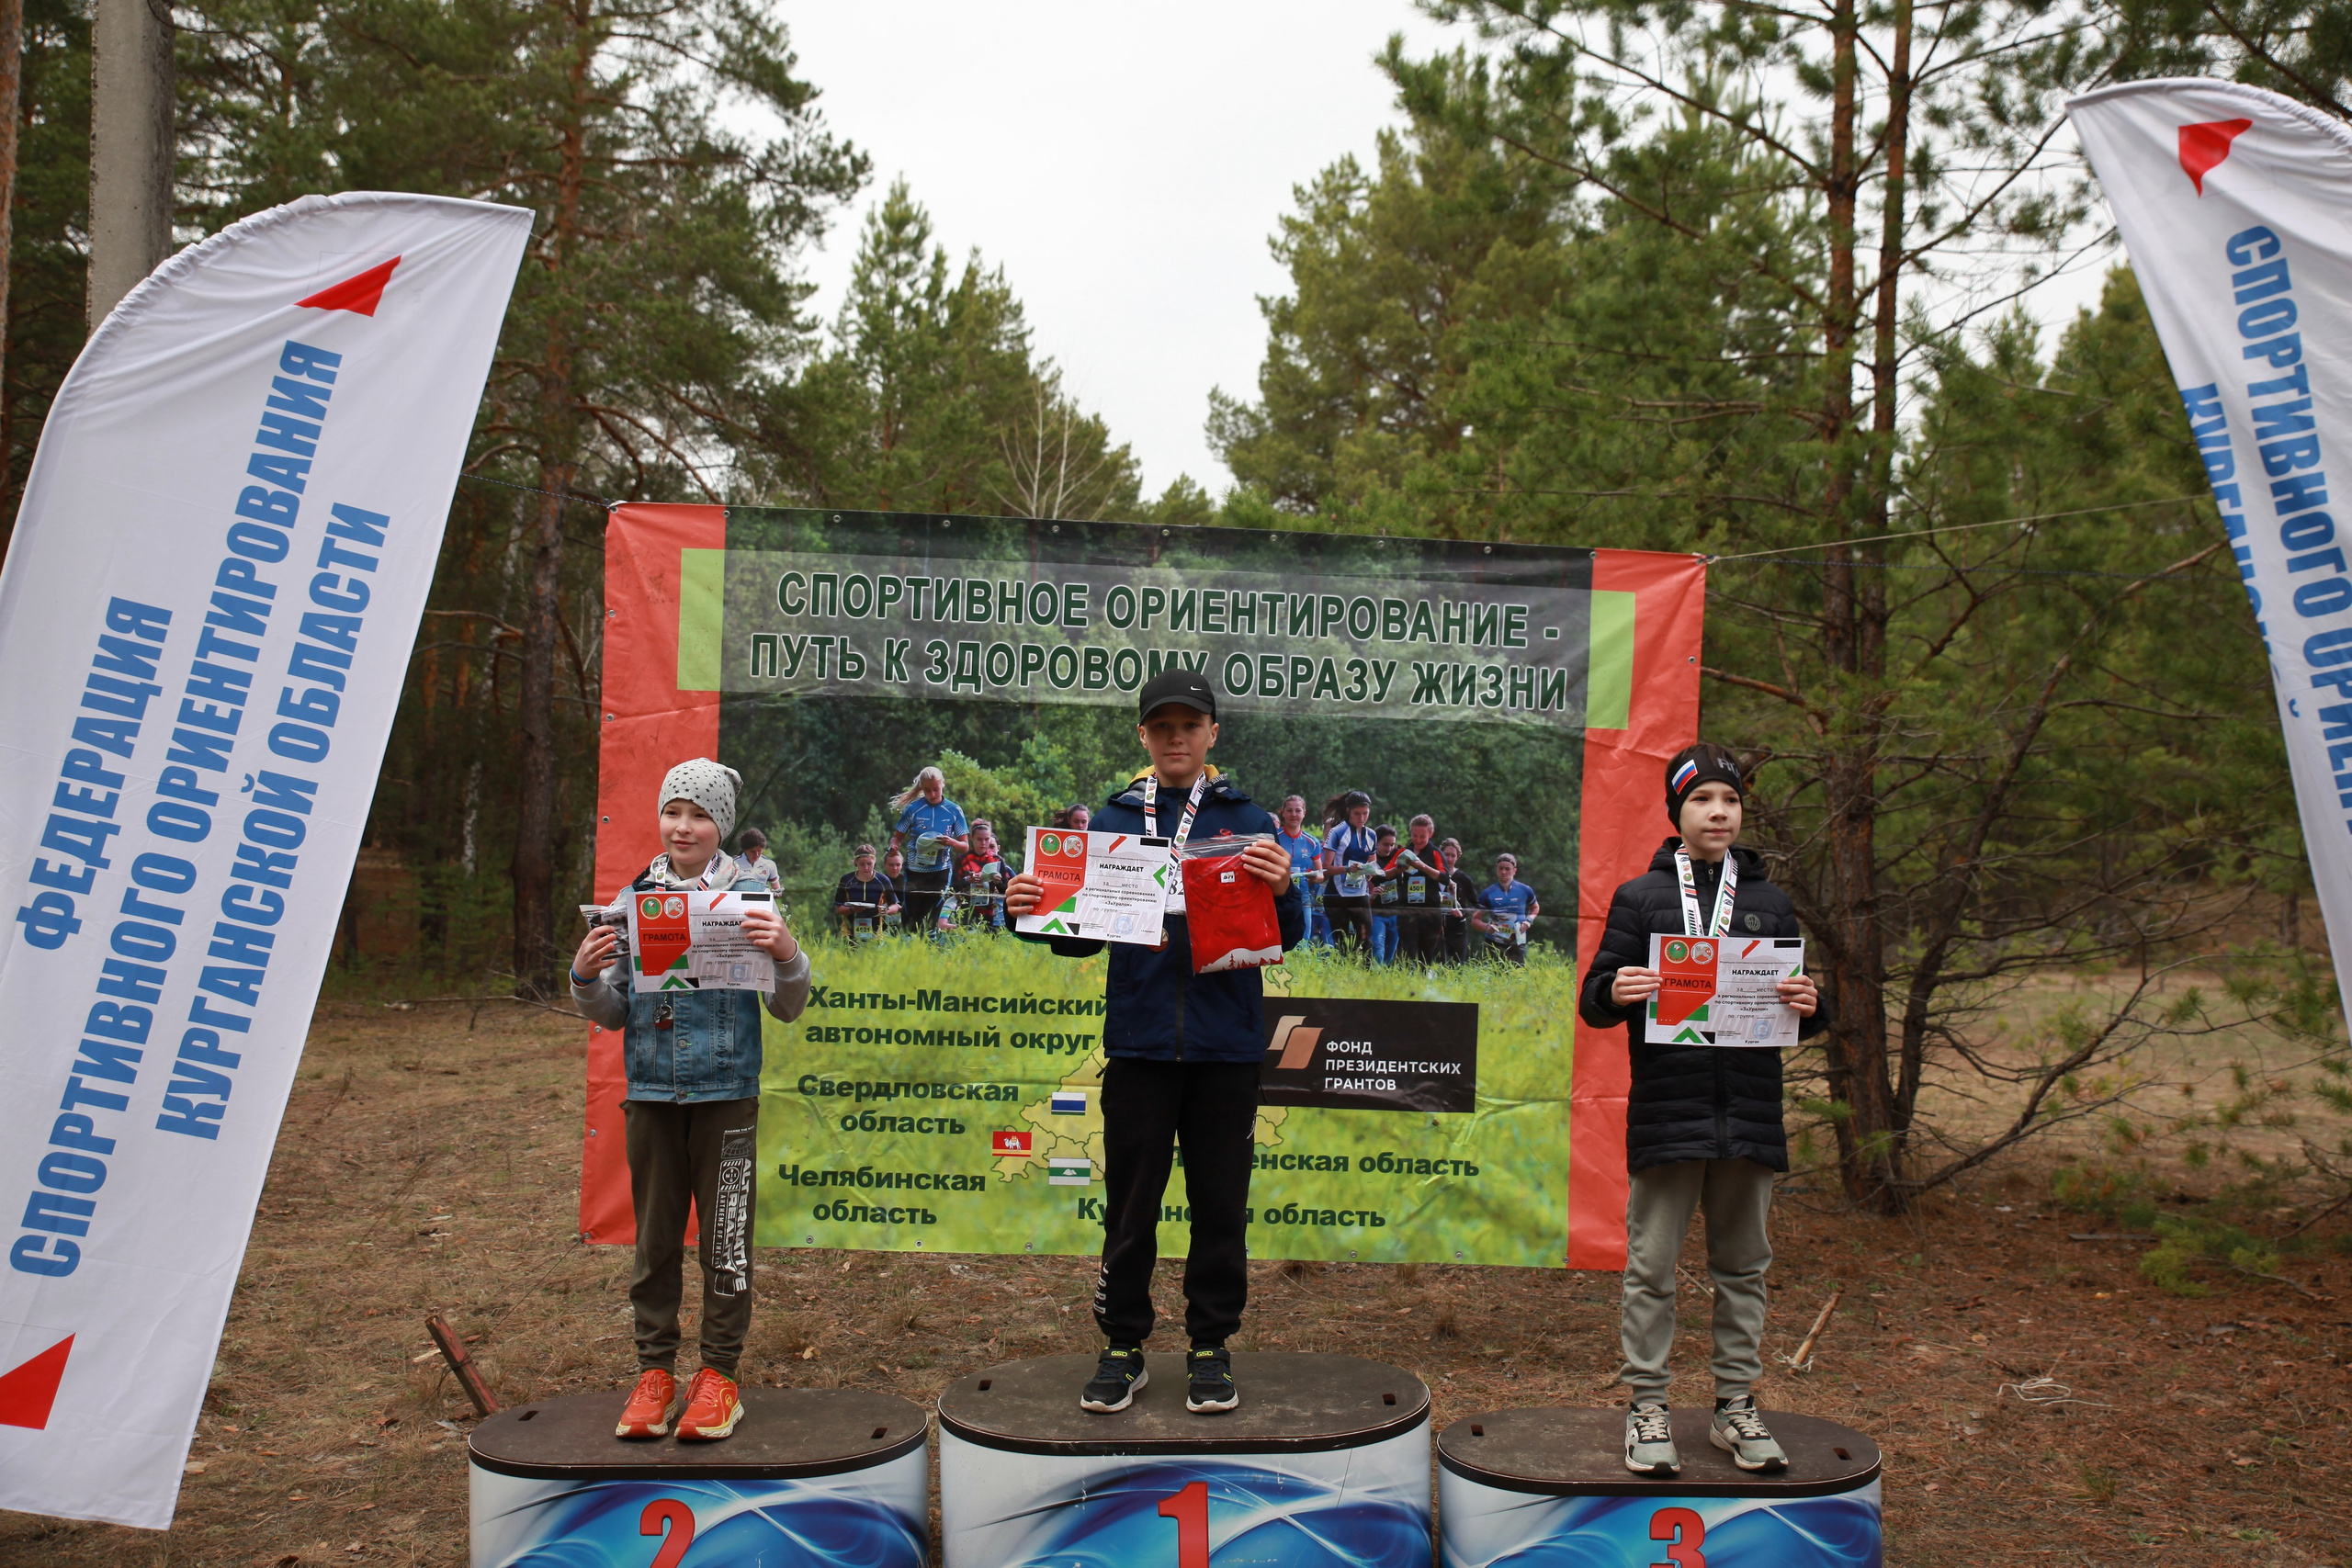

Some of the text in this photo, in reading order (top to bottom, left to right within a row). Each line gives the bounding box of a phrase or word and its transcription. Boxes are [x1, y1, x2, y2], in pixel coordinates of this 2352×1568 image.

[2226, 225, 2352, 618] СПОРТИВНОГО
[778, 571, 1089, 627] СПОРТИВНОЕ
[1105, 585, 1528, 648] ОРИЕНТИРОВАНИЕ
[751, 634, 866, 681] ПУТЬ
[884, 638, 910, 682] К
[1224, 652, 1398, 702] ОБРАЗУ
[1410, 662, 1566, 710] ЖИЗНИ
[17, 596, 173, 950] ФЕДЕРАЦИЯ
[9, 340, 343, 1277] СПОРТИВНОГО ОРИЕНТИРОВАНИЯ
[155, 502, 390, 1140] КУРГАНСКОЙ ОБЛАСТИ
[1037, 869, 1080, 882] ГРАМОТА
[1099, 863, 1145, 872] НАГРАЖДАЕТ
[643, 932, 686, 942] ГРАМОТА
[1664, 978, 1713, 989] ГРАМОТА
[807, 986, 1107, 1016] Ханты-Мансийский
[806, 1025, 1095, 1055] автономный округ
[1326, 1041, 1373, 1055] ФОНД
[1325, 1059, 1462, 1075] ПРЕЗИДЕНТСКИХ
[797, 1074, 1019, 1102] Свердловская
[1325, 1077, 1396, 1090] ГРАНТОВ
[840, 1110, 966, 1134] область
[778, 1164, 986, 1191] Челябинская
[1359, 1152, 1480, 1176] область
[717, 1194, 726, 1227] ANTHEMS
[732, 1157, 752, 1292] ALTERNATIVE
[812, 1200, 937, 1224] область
[1263, 1202, 1386, 1227] область
[723, 1192, 738, 1273] REALITY
[640, 1498, 695, 1568] 2
[1158, 1481, 1209, 1568] 1
[1649, 1506, 1706, 1568] 3
